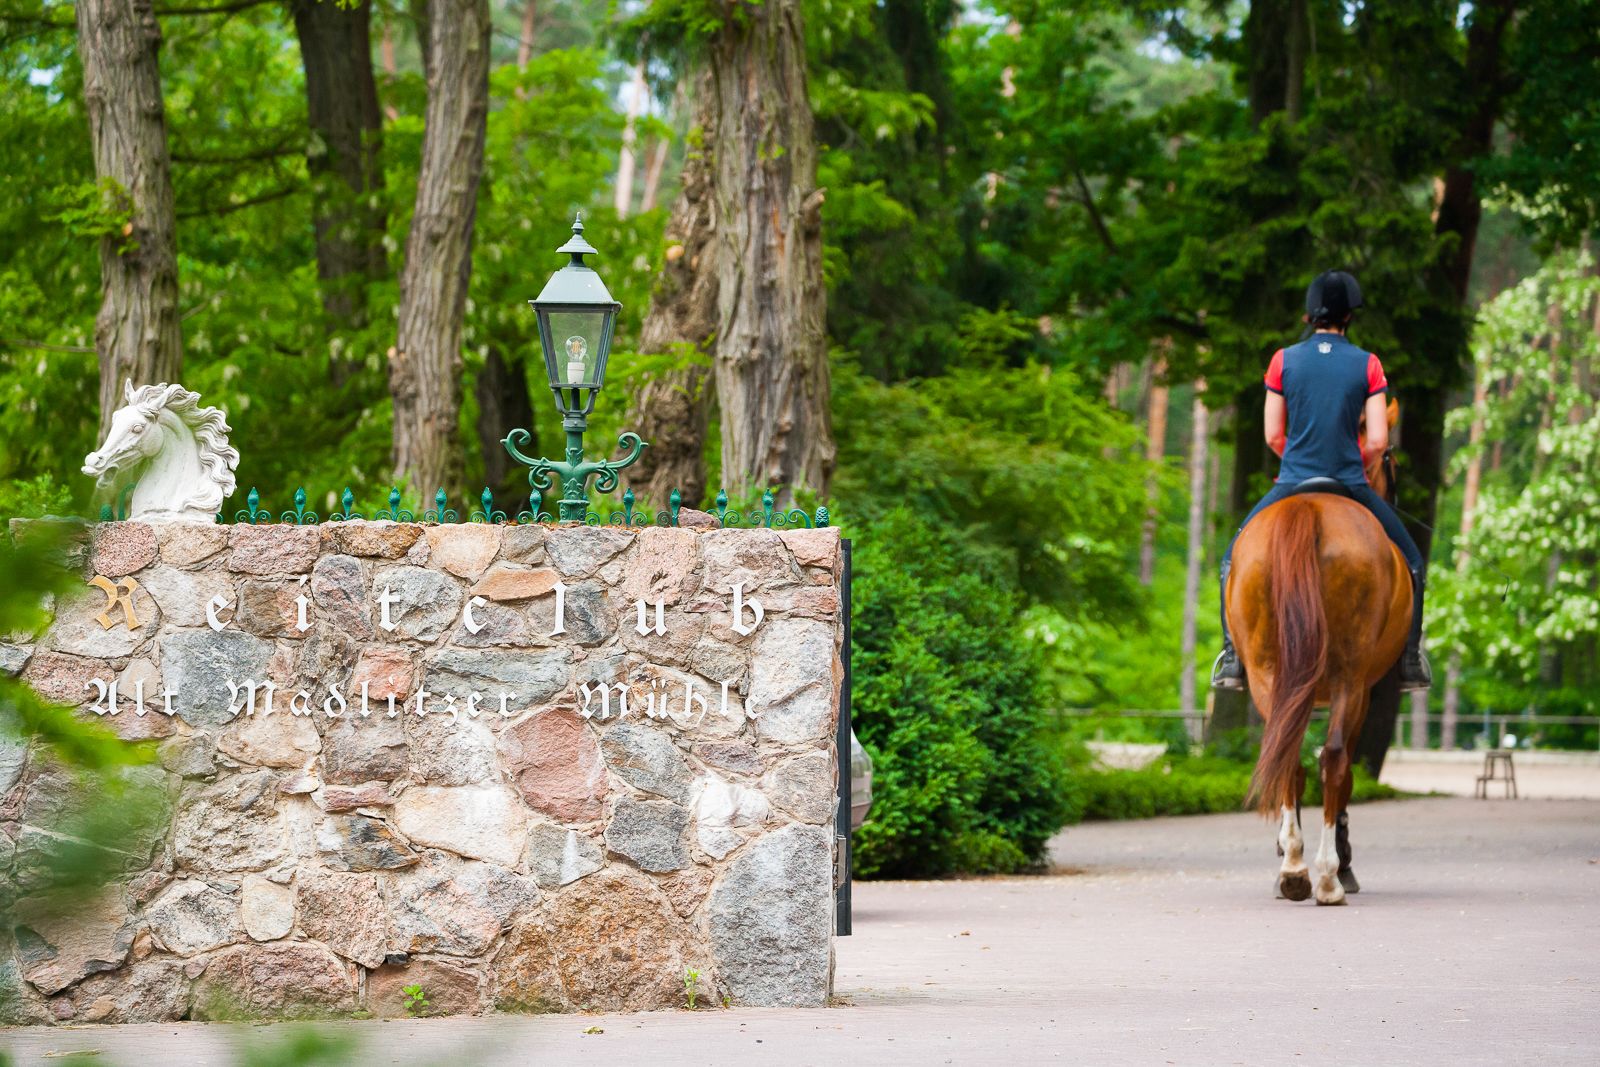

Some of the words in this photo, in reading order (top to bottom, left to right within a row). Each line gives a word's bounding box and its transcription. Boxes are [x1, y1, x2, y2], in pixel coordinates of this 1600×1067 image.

[87, 575, 765, 636] Reitclub
[85, 677, 179, 716] Alt
[226, 678, 517, 726] Madlitzer
[579, 679, 763, 724] Mühle
